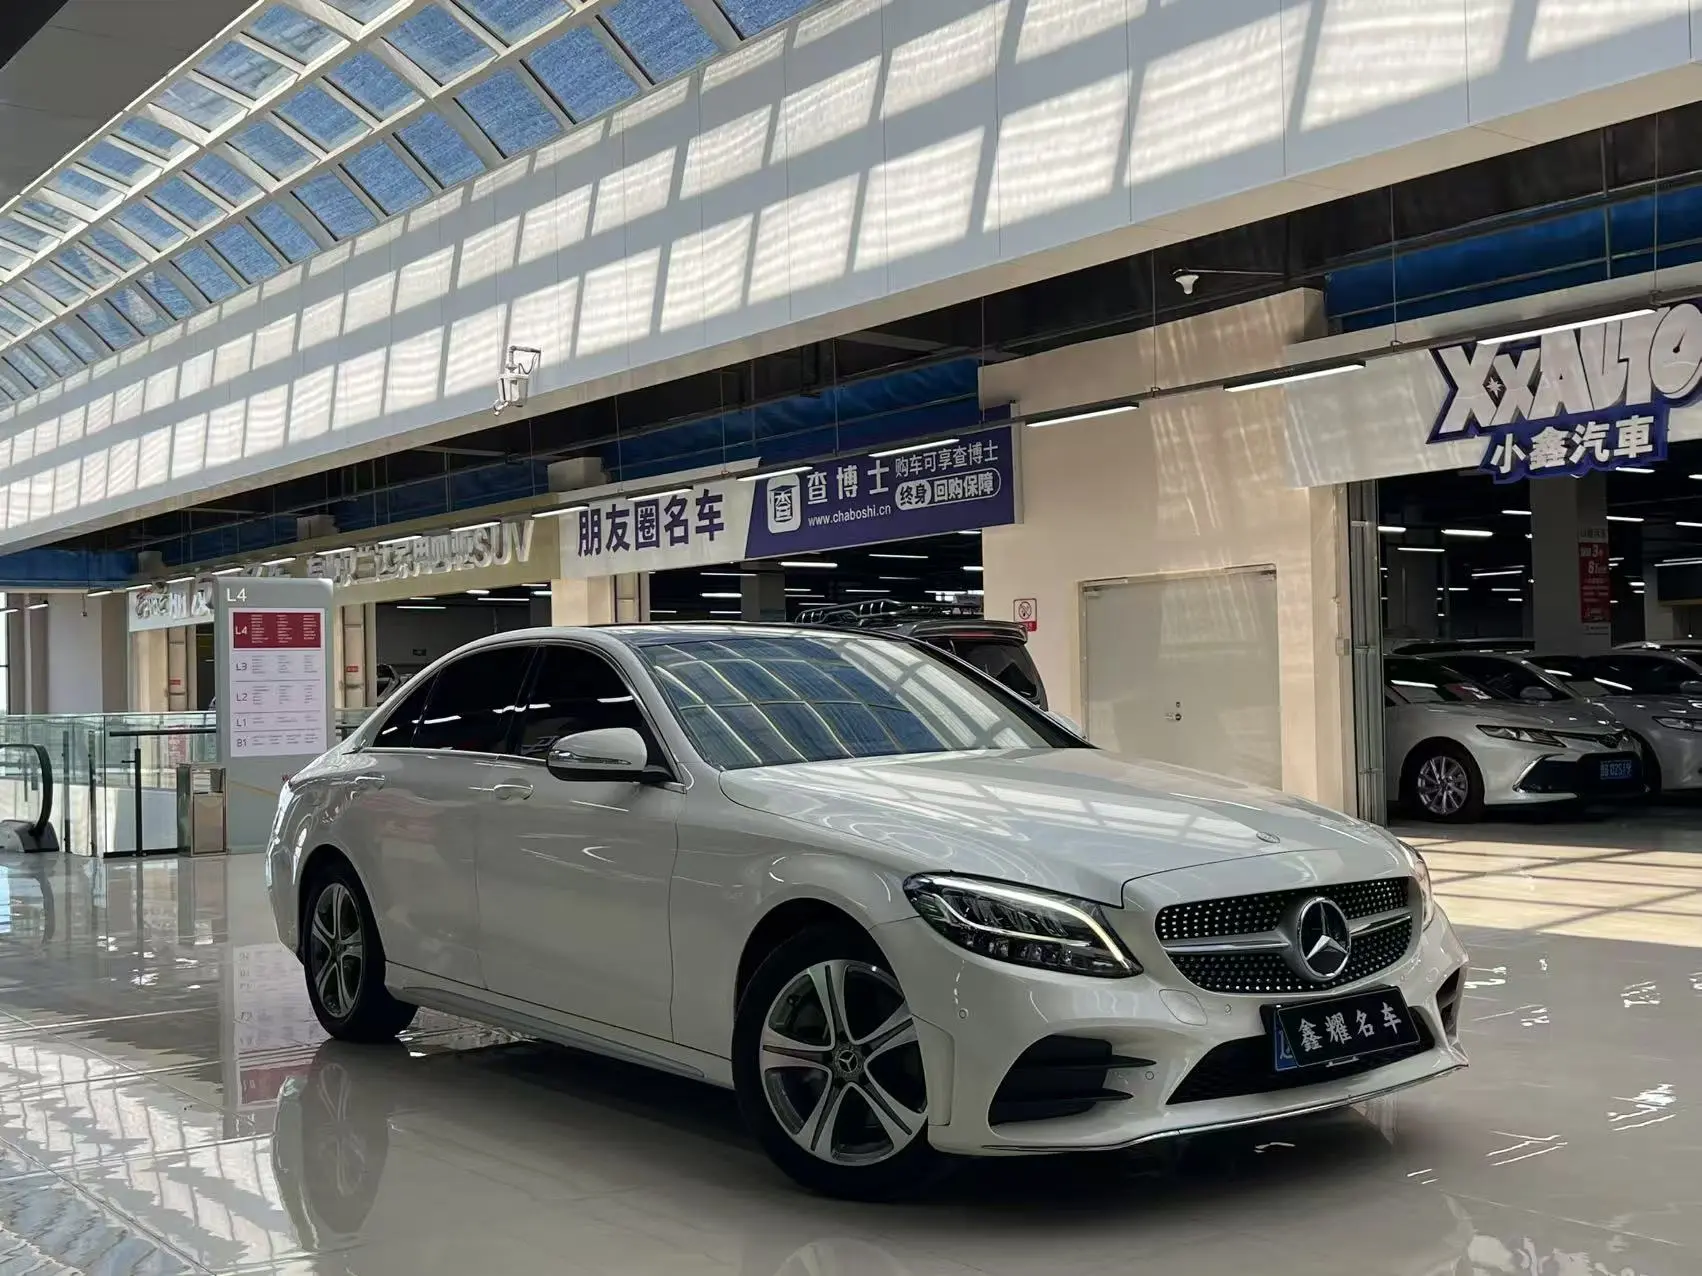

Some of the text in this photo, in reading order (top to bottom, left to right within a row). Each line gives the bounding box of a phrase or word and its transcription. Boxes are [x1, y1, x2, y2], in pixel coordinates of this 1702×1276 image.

[1490, 415, 1655, 475] 小鑫汽車
[894, 439, 999, 479] 购车可享查博士
[806, 459, 890, 505] 查博士
[577, 488, 725, 557] 朋友圈名车
[807, 502, 892, 527] www.chaboshi.cn
[226, 587, 248, 602] L4
[235, 625, 248, 635] L4
[235, 662, 248, 671] L3
[236, 692, 248, 702] L2
[236, 718, 247, 727] L1
[236, 738, 248, 748] B1
[1297, 1001, 1402, 1053] 鑫耀名车
